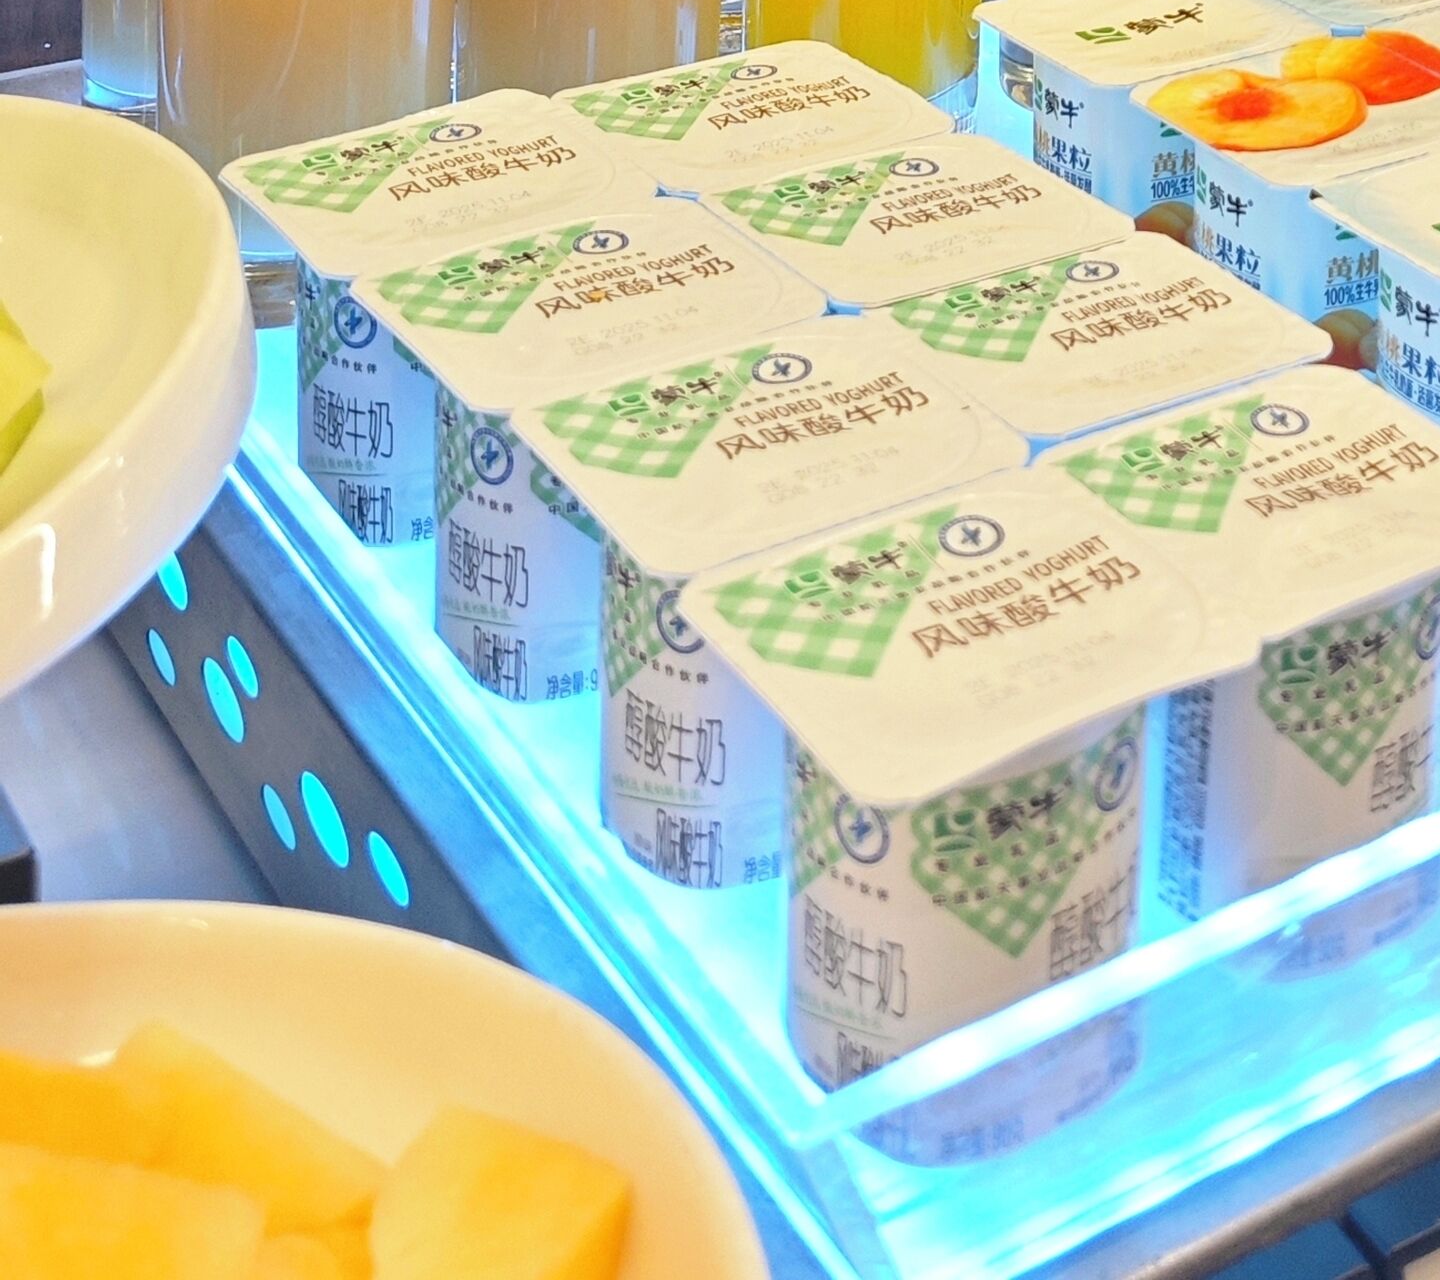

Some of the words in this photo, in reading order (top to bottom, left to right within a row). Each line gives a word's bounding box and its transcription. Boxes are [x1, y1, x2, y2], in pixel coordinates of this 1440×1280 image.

[1124, 7, 1203, 35] 蒙牛
[708, 84, 871, 131] 风味酸牛奶
[720, 91, 787, 111] FLAVORED
[791, 74, 851, 94] YOGHURT
[1045, 88, 1079, 129] 蒙牛
[388, 146, 577, 202] 风味酸牛奶
[407, 151, 485, 178] FLAVORED
[489, 135, 560, 159] YOGHURT
[869, 184, 1042, 235] 风味酸牛奶
[881, 187, 955, 212] FLAVORED
[953, 172, 1020, 195] YOGHURT
[1209, 182, 1247, 227] 蒙牛
[535, 257, 735, 319] 风味酸牛奶
[553, 265, 638, 292] FLAVORED
[640, 243, 714, 272] YOGHURT
[1050, 288, 1234, 352] 风味酸牛奶
[1061, 296, 1138, 324] FLAVORED
[1138, 276, 1206, 304] YOGHURT
[1395, 286, 1439, 336] 蒙牛
[715, 386, 930, 460] 风味酸牛奶
[733, 397, 823, 429] FLAVORED
[826, 371, 906, 404] YOGHURT
[1244, 440, 1440, 518] 风味酸牛奶
[1252, 456, 1336, 490] FLAVORED
[1334, 422, 1409, 461] YOGHURT
[927, 577, 1024, 617] FLAVORED
[1023, 534, 1112, 580] YOGHURT
[911, 556, 1142, 659] 风味酸牛奶
[1327, 631, 1391, 676] 蒙牛
[986, 788, 1064, 840] 蒙牛
